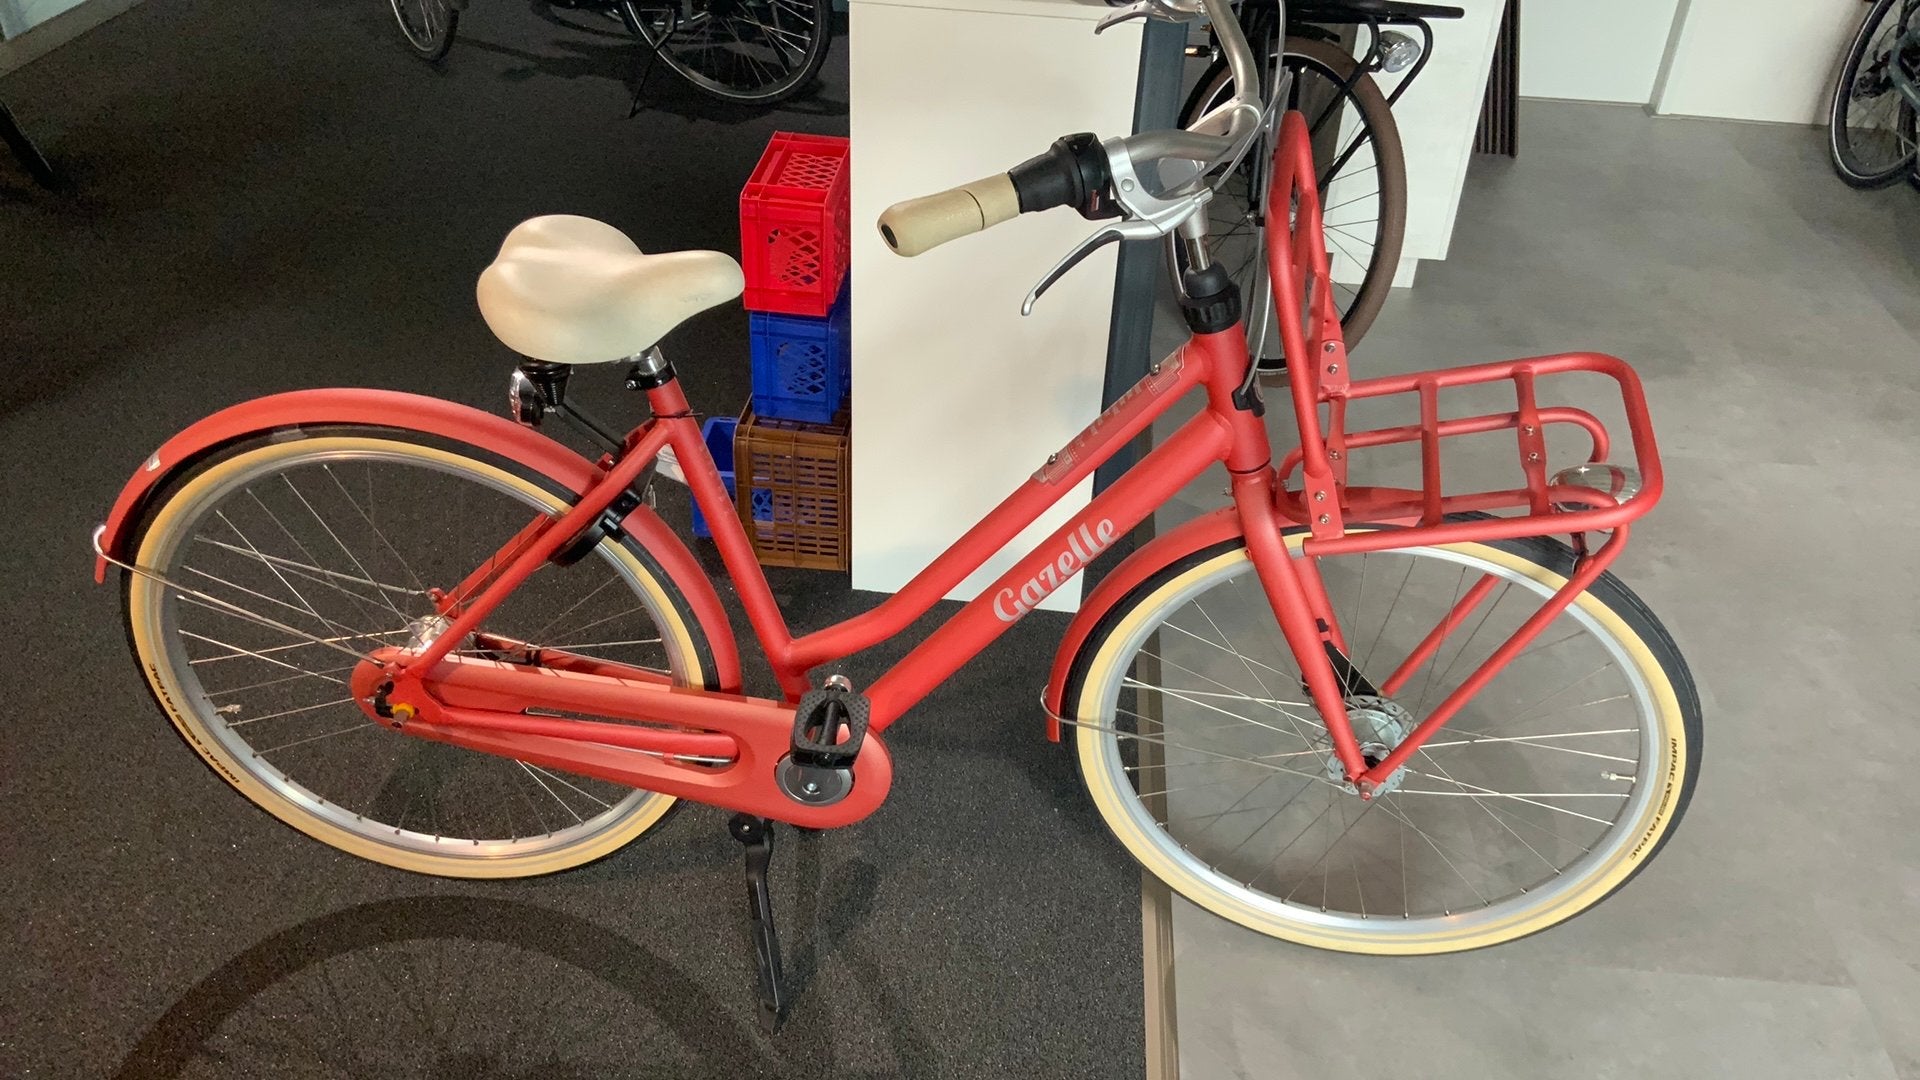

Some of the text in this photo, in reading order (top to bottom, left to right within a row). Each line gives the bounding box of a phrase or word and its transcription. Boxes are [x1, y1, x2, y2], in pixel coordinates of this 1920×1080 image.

[993, 518, 1120, 622] Gazelle
[149, 663, 240, 783] IMPAC FATPAC
[1629, 738, 1678, 860] IMPAC FATPAC
